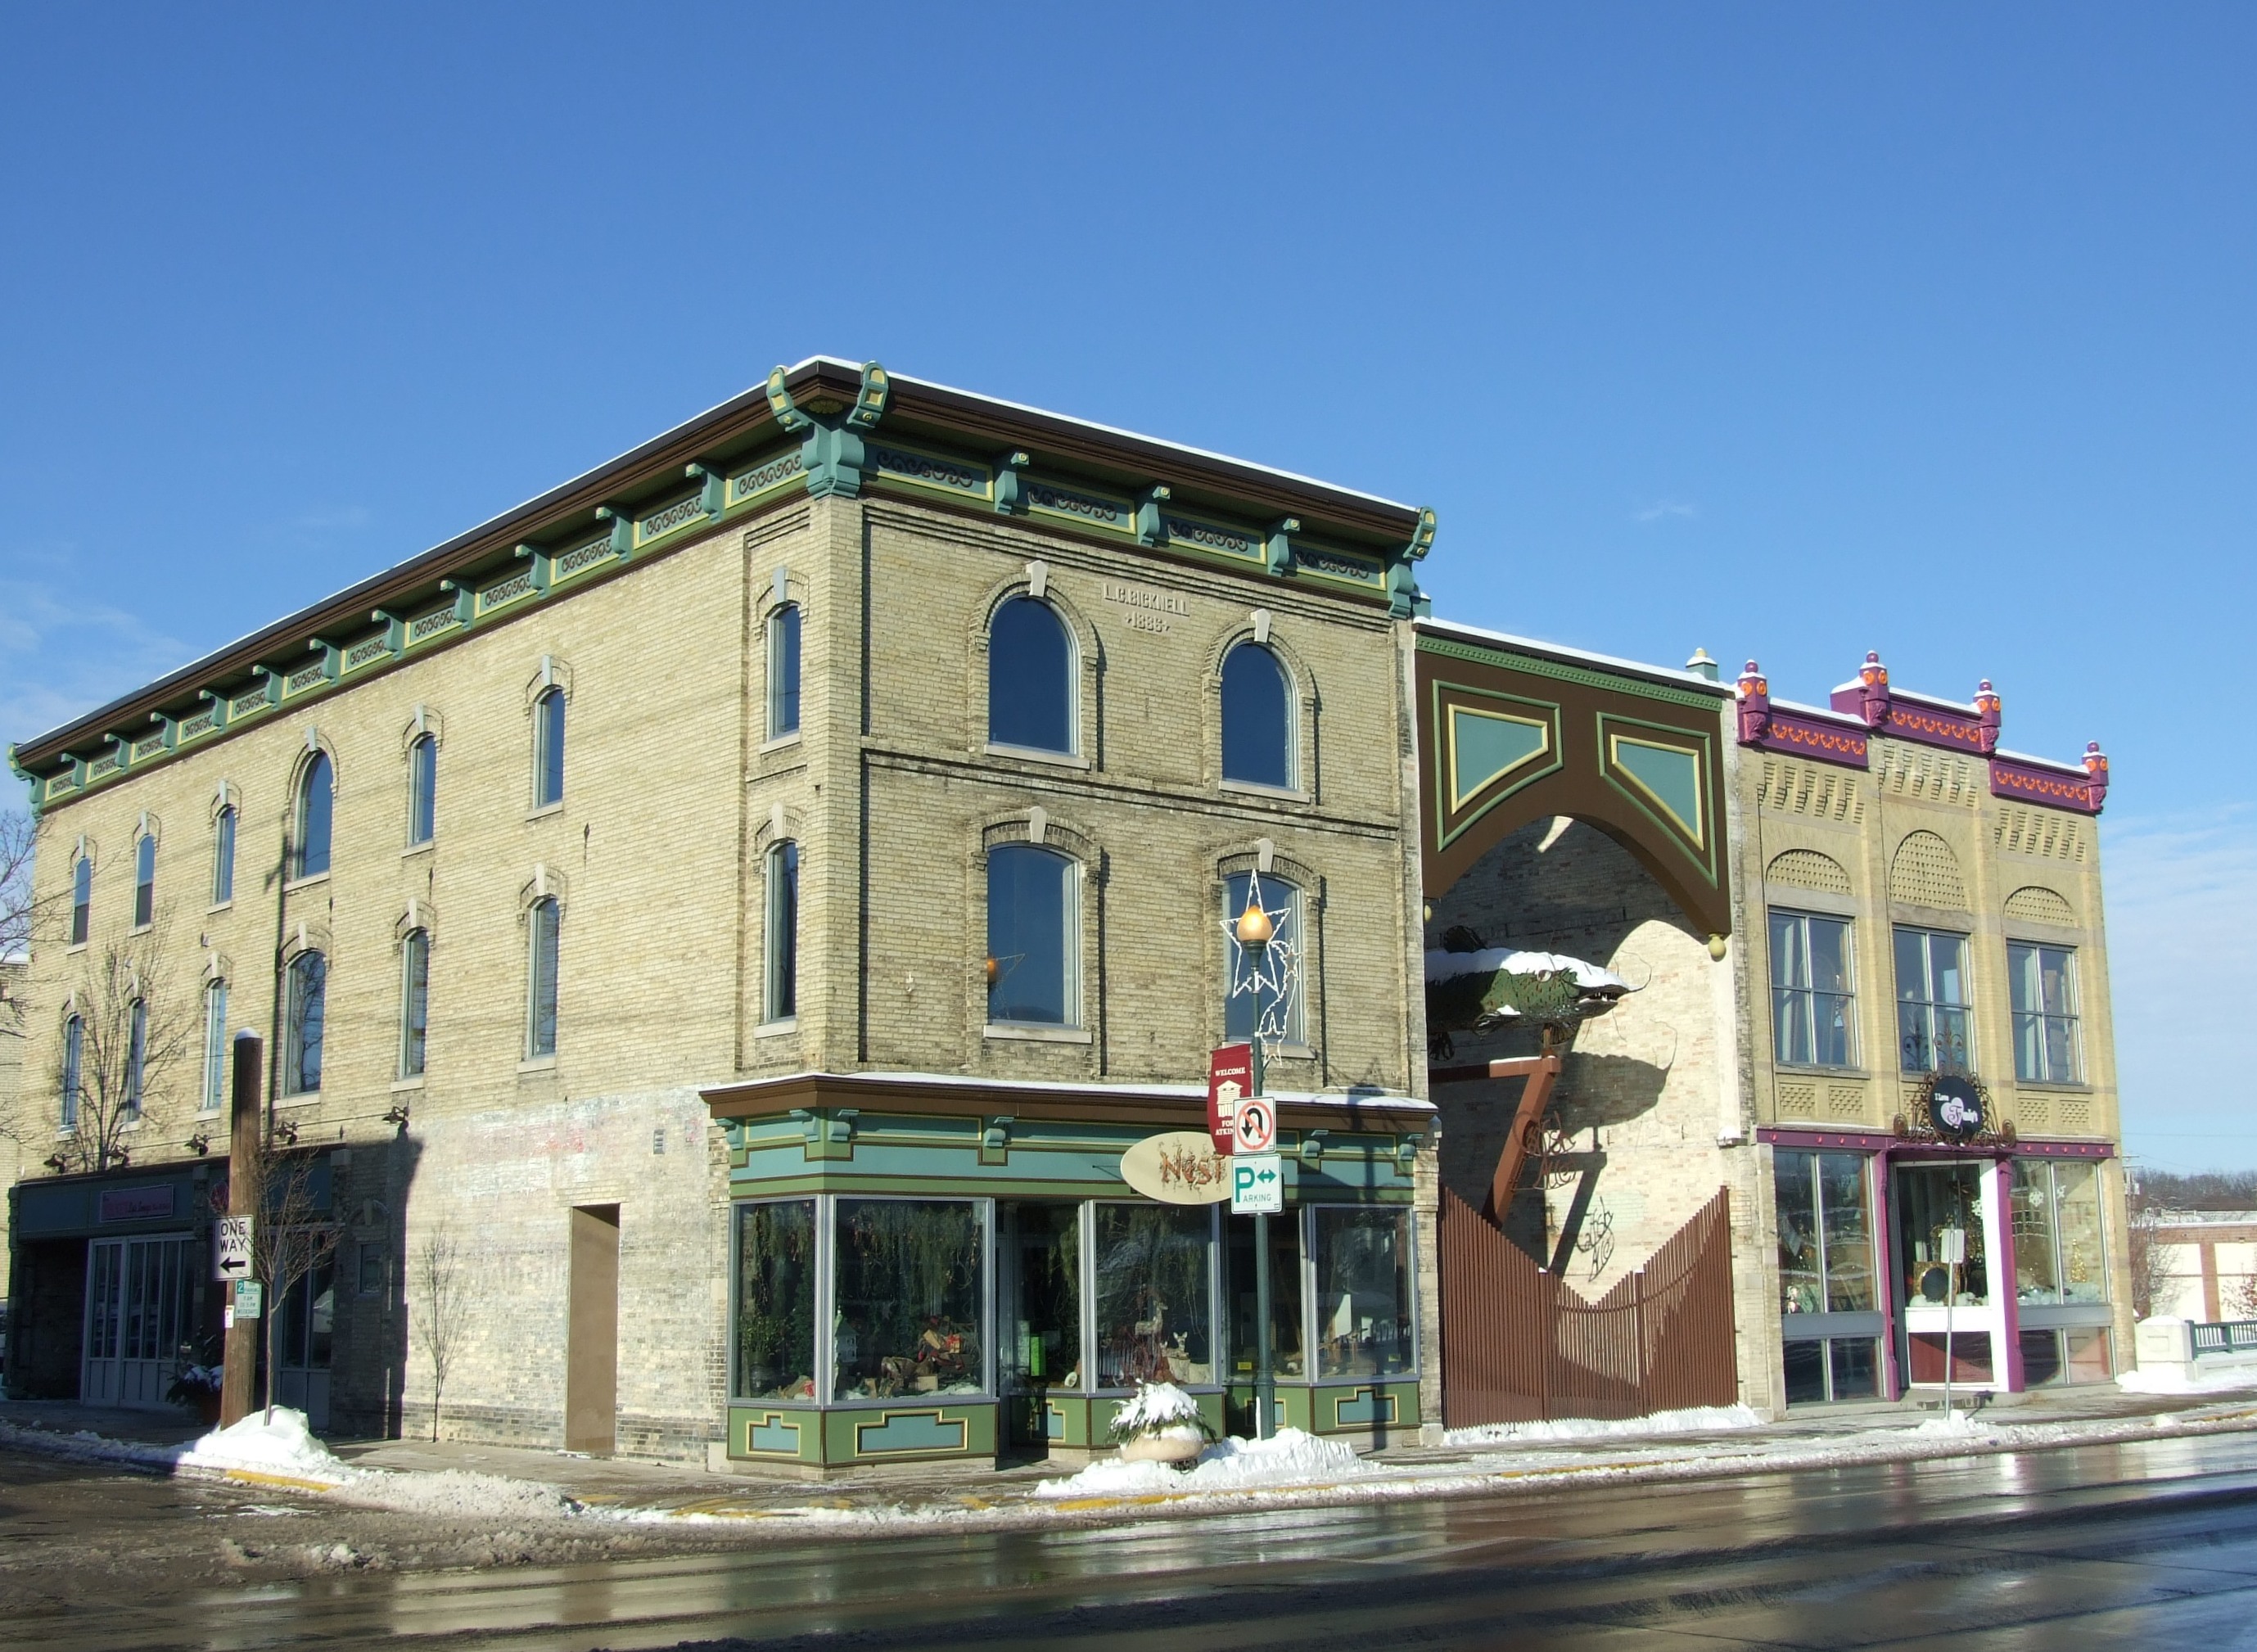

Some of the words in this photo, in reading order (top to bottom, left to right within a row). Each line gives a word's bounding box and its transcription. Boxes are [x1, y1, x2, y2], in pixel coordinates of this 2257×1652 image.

[1215, 1067, 1246, 1077] WELCOME
[1235, 1167, 1271, 1203] PARKING
[220, 1221, 246, 1236] ONE
[220, 1238, 246, 1253] WAY
[237, 1282, 244, 1293] 2
